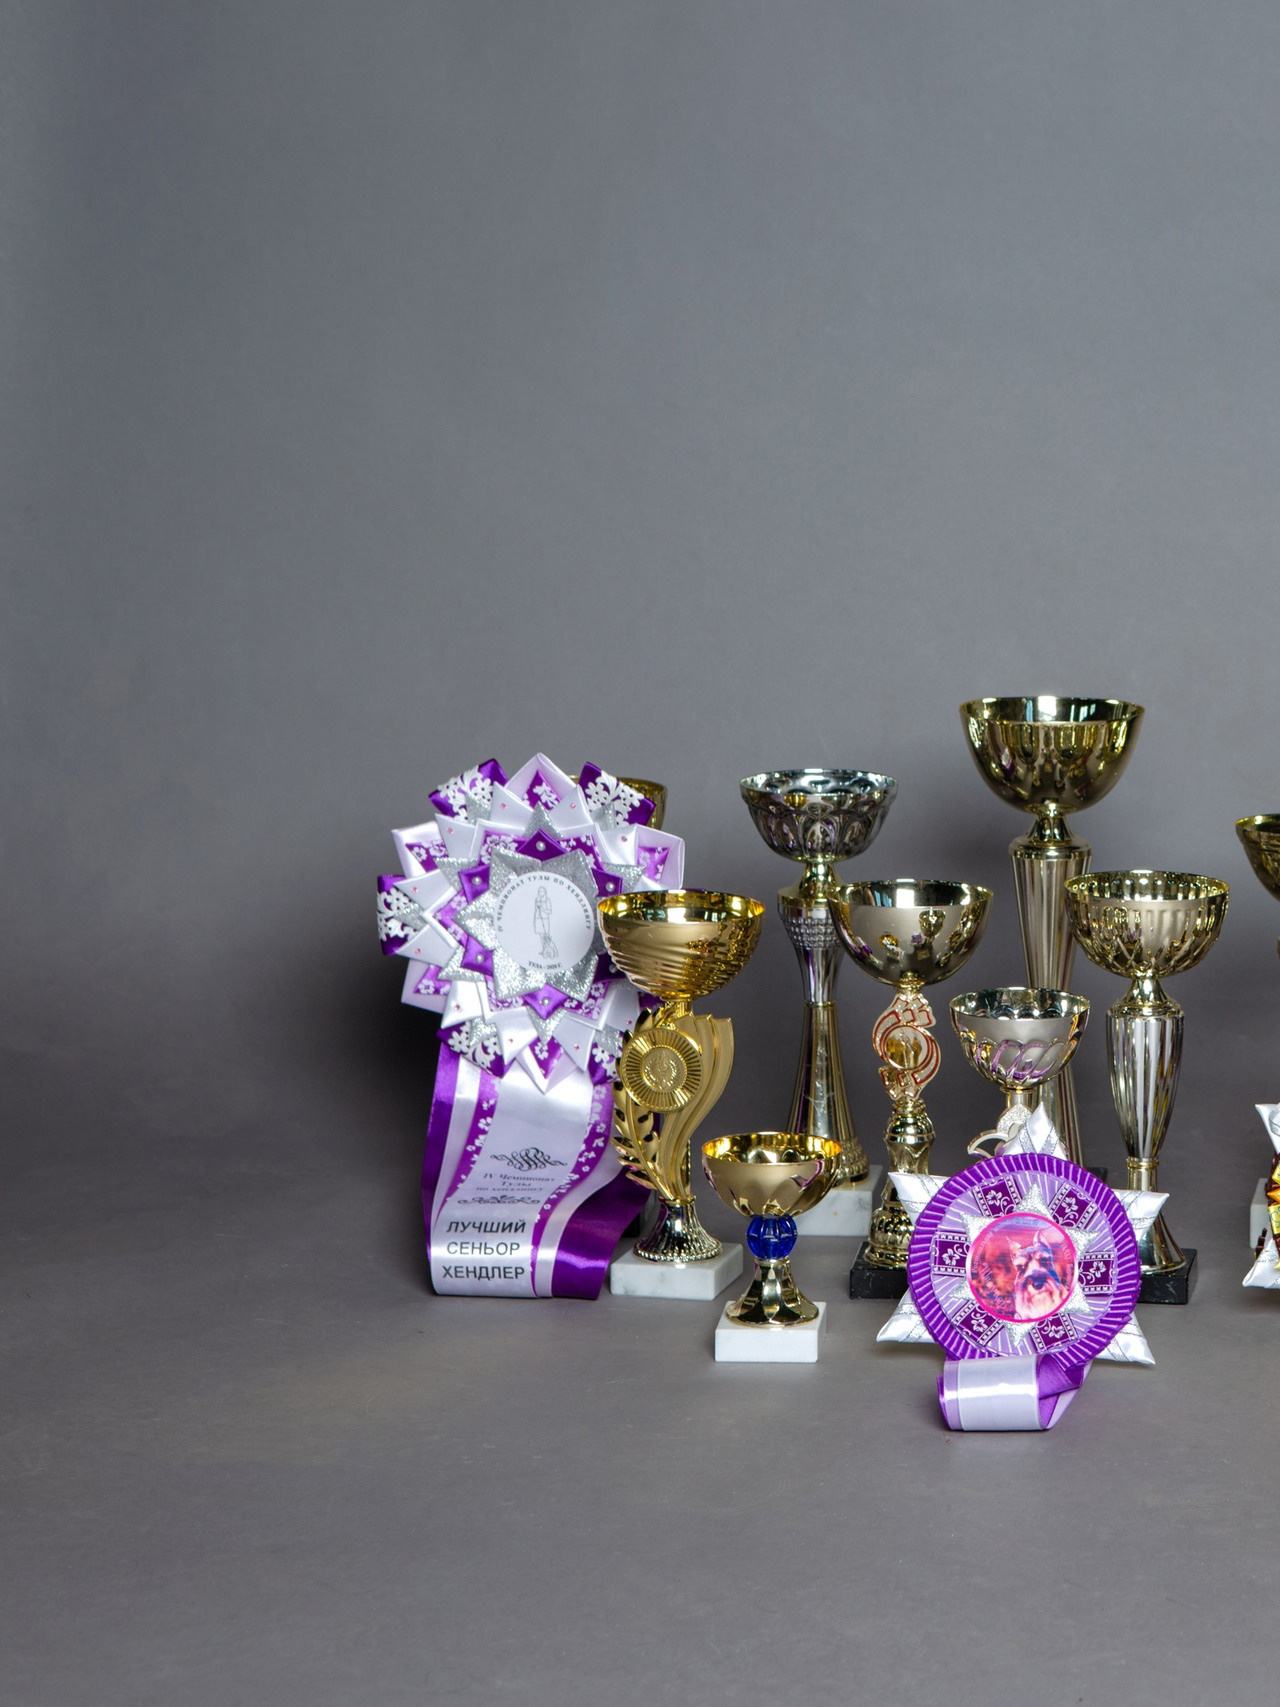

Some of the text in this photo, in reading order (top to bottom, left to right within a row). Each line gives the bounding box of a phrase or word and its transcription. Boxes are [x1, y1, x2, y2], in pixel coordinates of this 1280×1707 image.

[497, 878, 525, 922] ЧЕМПИОНАТ
[528, 874, 551, 882] ТУЛЫ
[553, 877, 565, 886] ПО
[446, 1219, 526, 1234] ЛУЧШИЙ
[446, 1241, 520, 1256] СЕНЬОР
[442, 1265, 525, 1282] ХЕНДЛЕР
